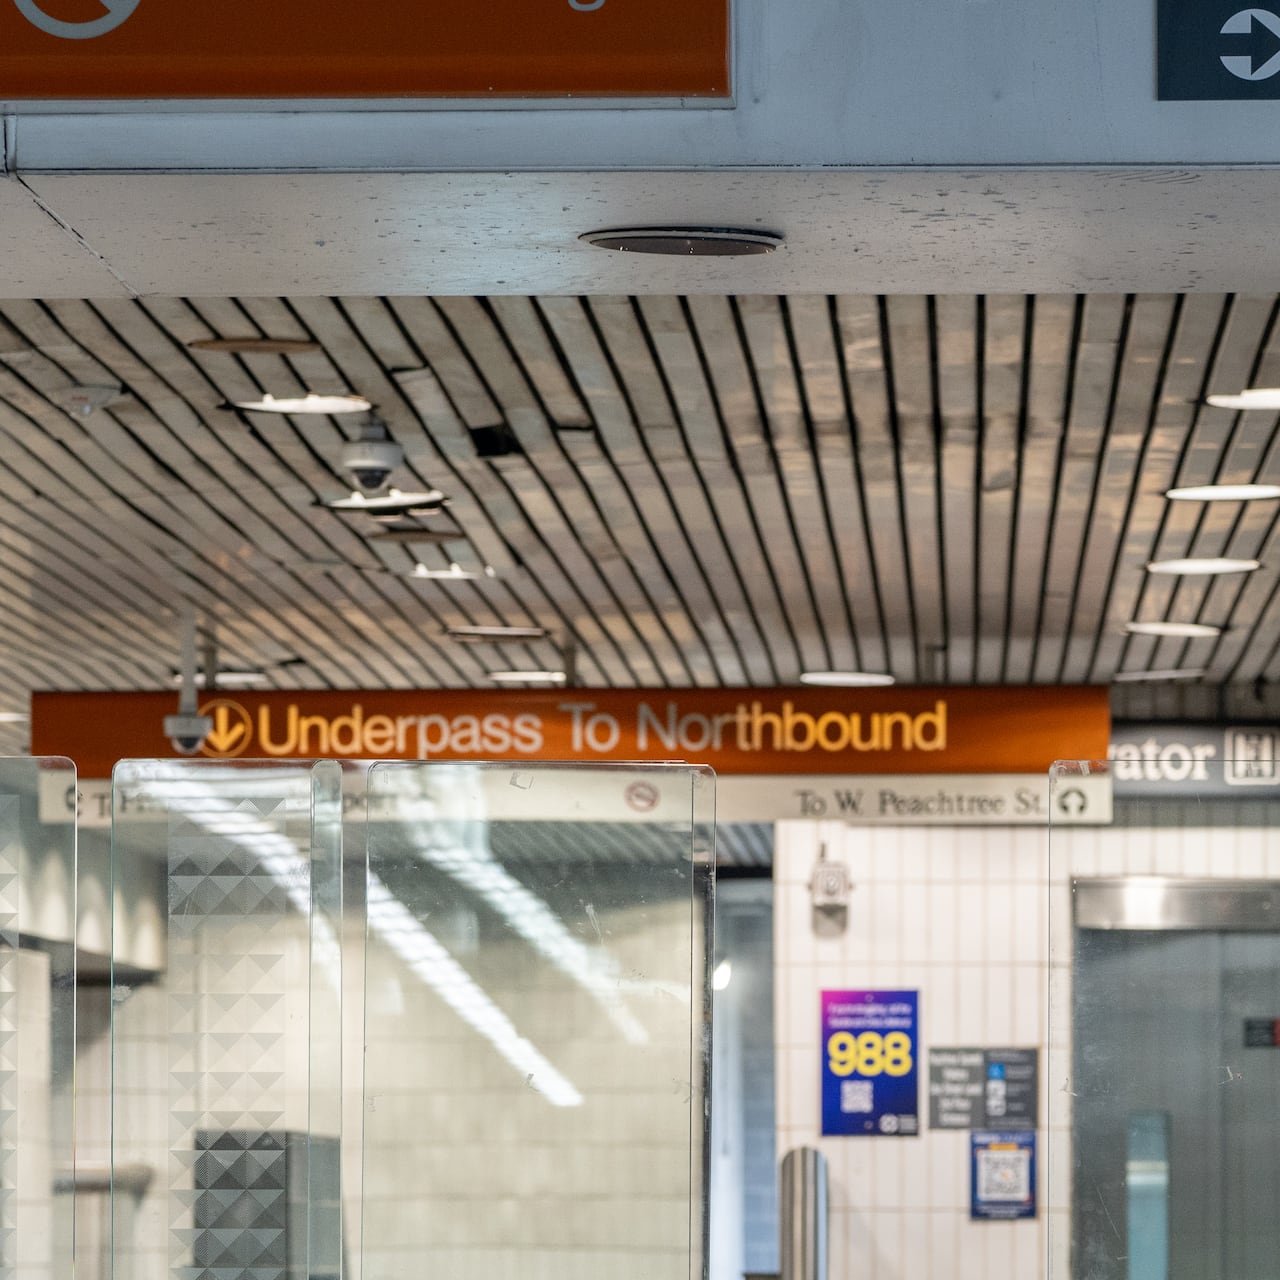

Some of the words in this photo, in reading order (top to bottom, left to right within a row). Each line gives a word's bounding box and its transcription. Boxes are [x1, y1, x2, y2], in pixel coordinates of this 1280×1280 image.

[261, 704, 544, 758] Underpass
[557, 702, 621, 751] To
[636, 700, 948, 753] Northbound
[794, 789, 828, 816] To
[878, 788, 1007, 816] Peachtree
[828, 1031, 913, 1077] 988
